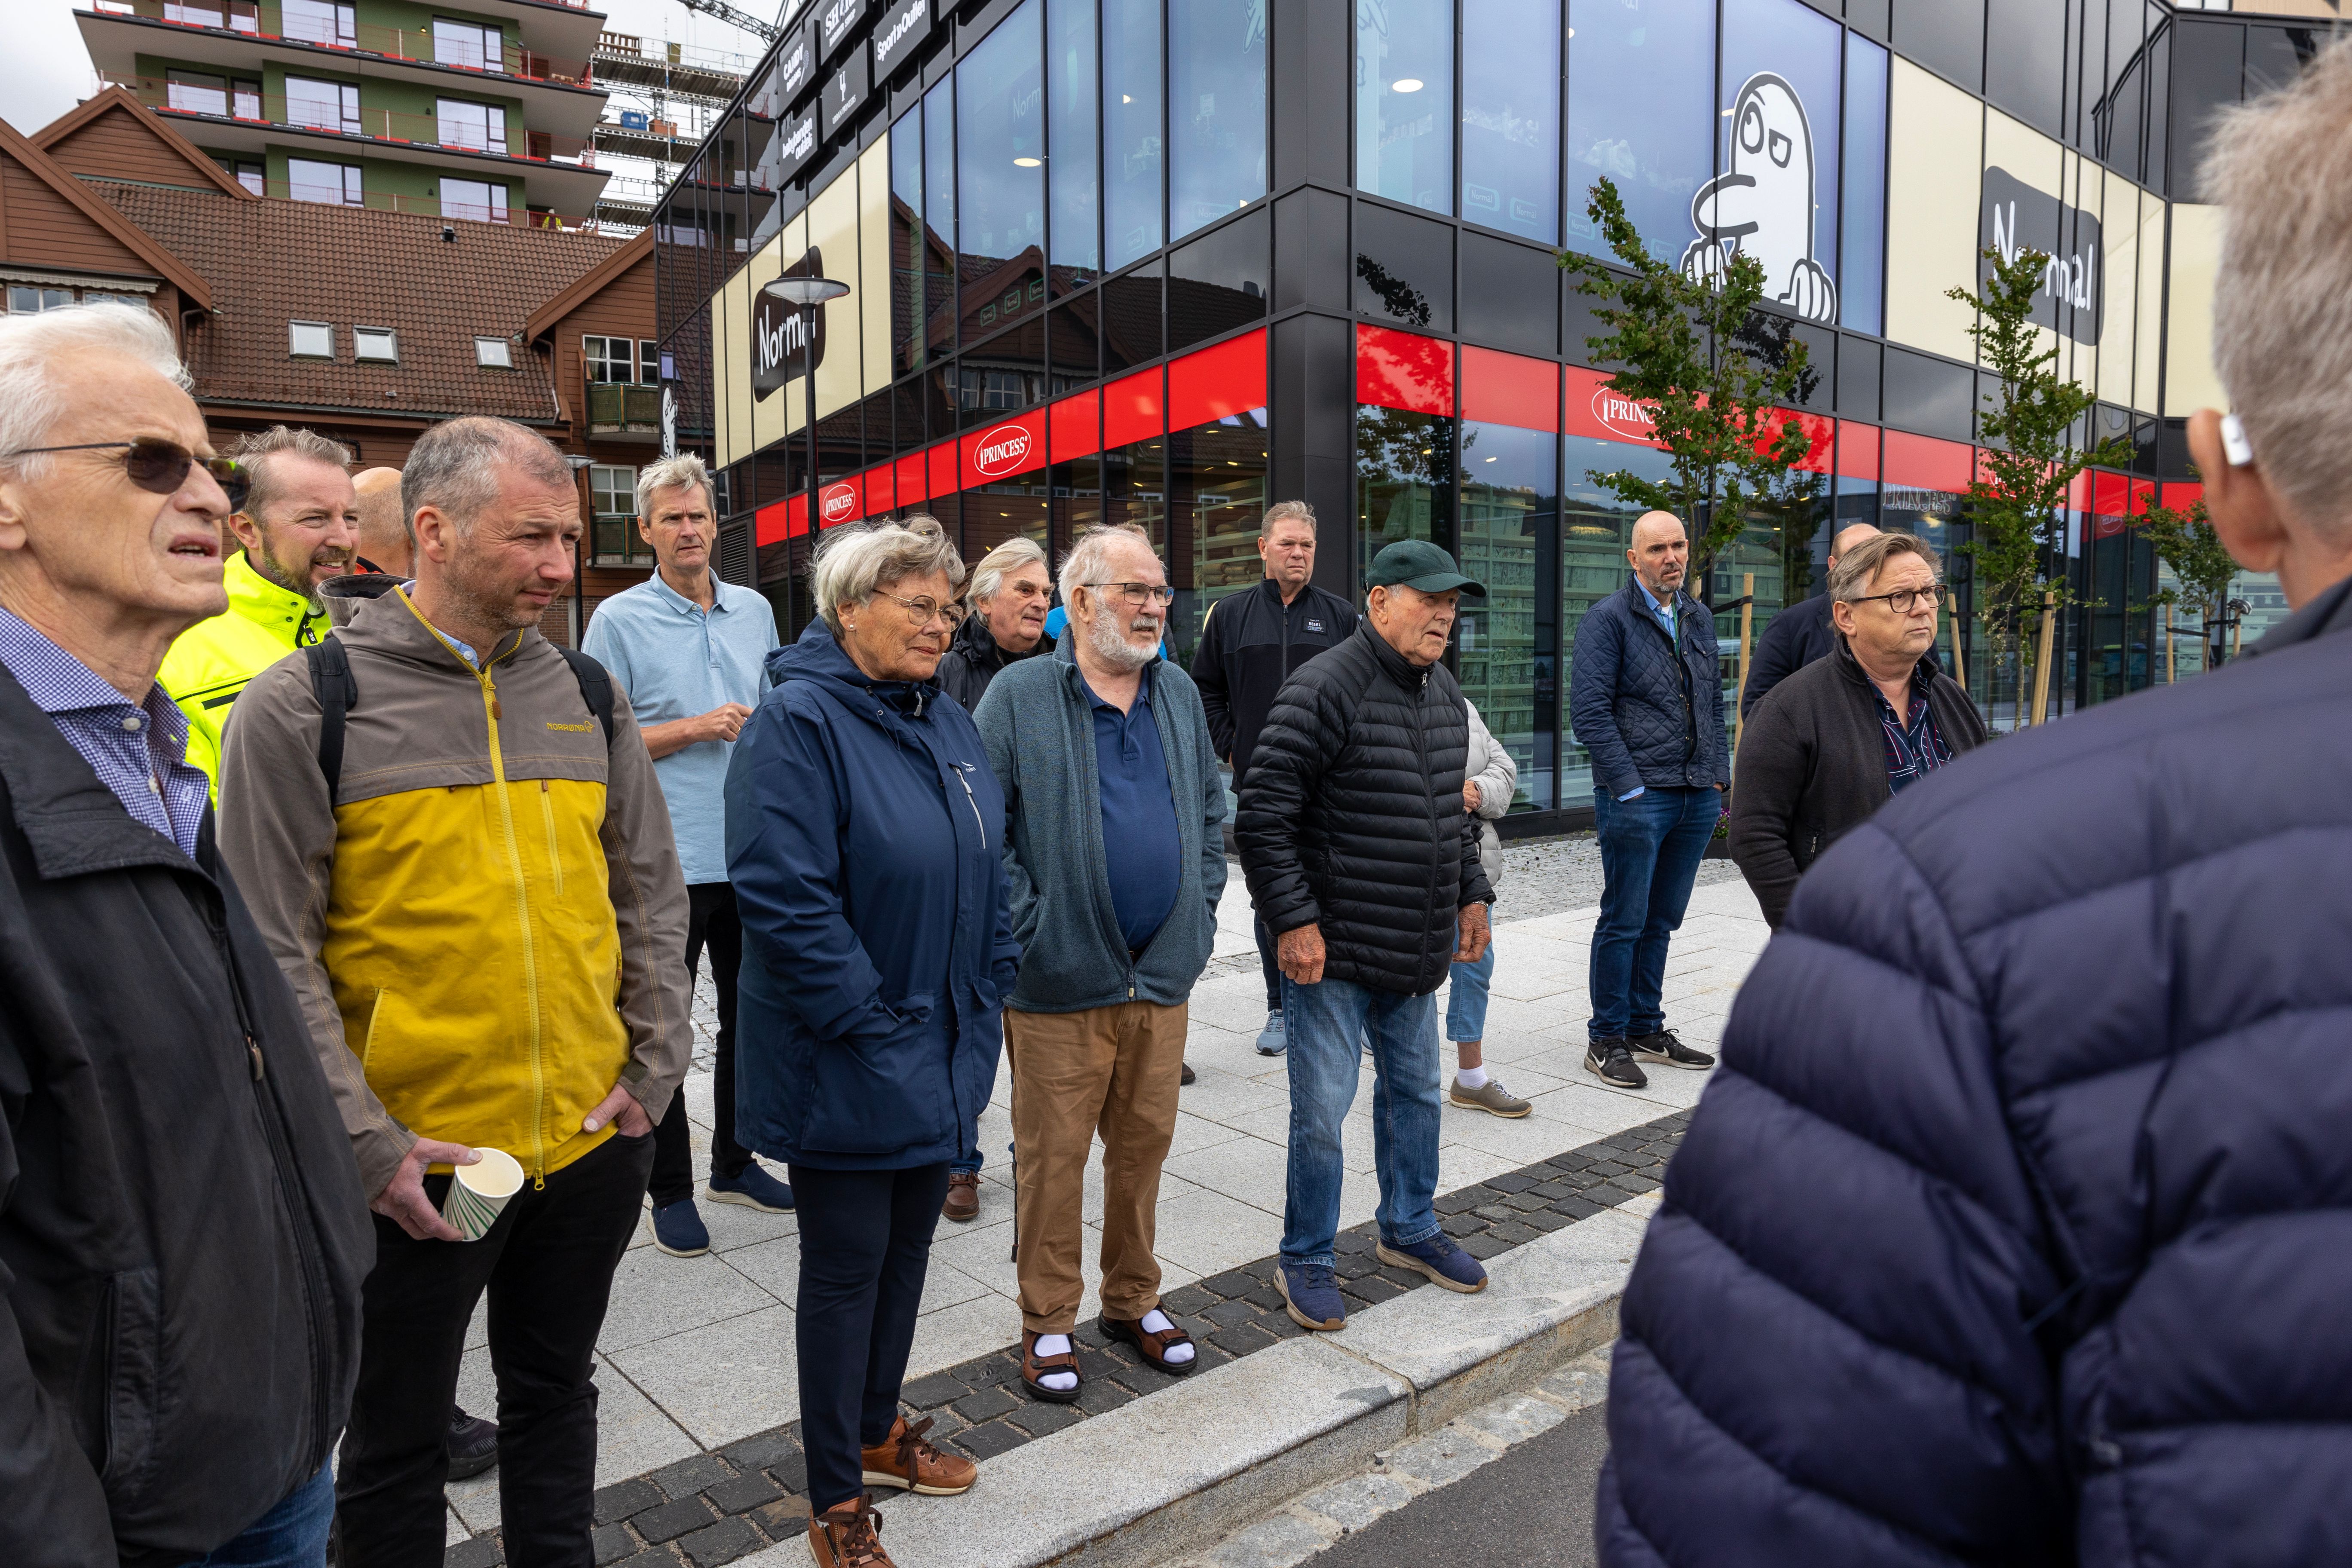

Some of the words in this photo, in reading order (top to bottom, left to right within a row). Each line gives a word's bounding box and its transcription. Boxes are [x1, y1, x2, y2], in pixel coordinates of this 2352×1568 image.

[784, 43, 803, 80] CANDY
[1471, 190, 1492, 202] Normal
[983, 436, 1025, 465] PRINCESS
[828, 493, 852, 513] PRINCESS
